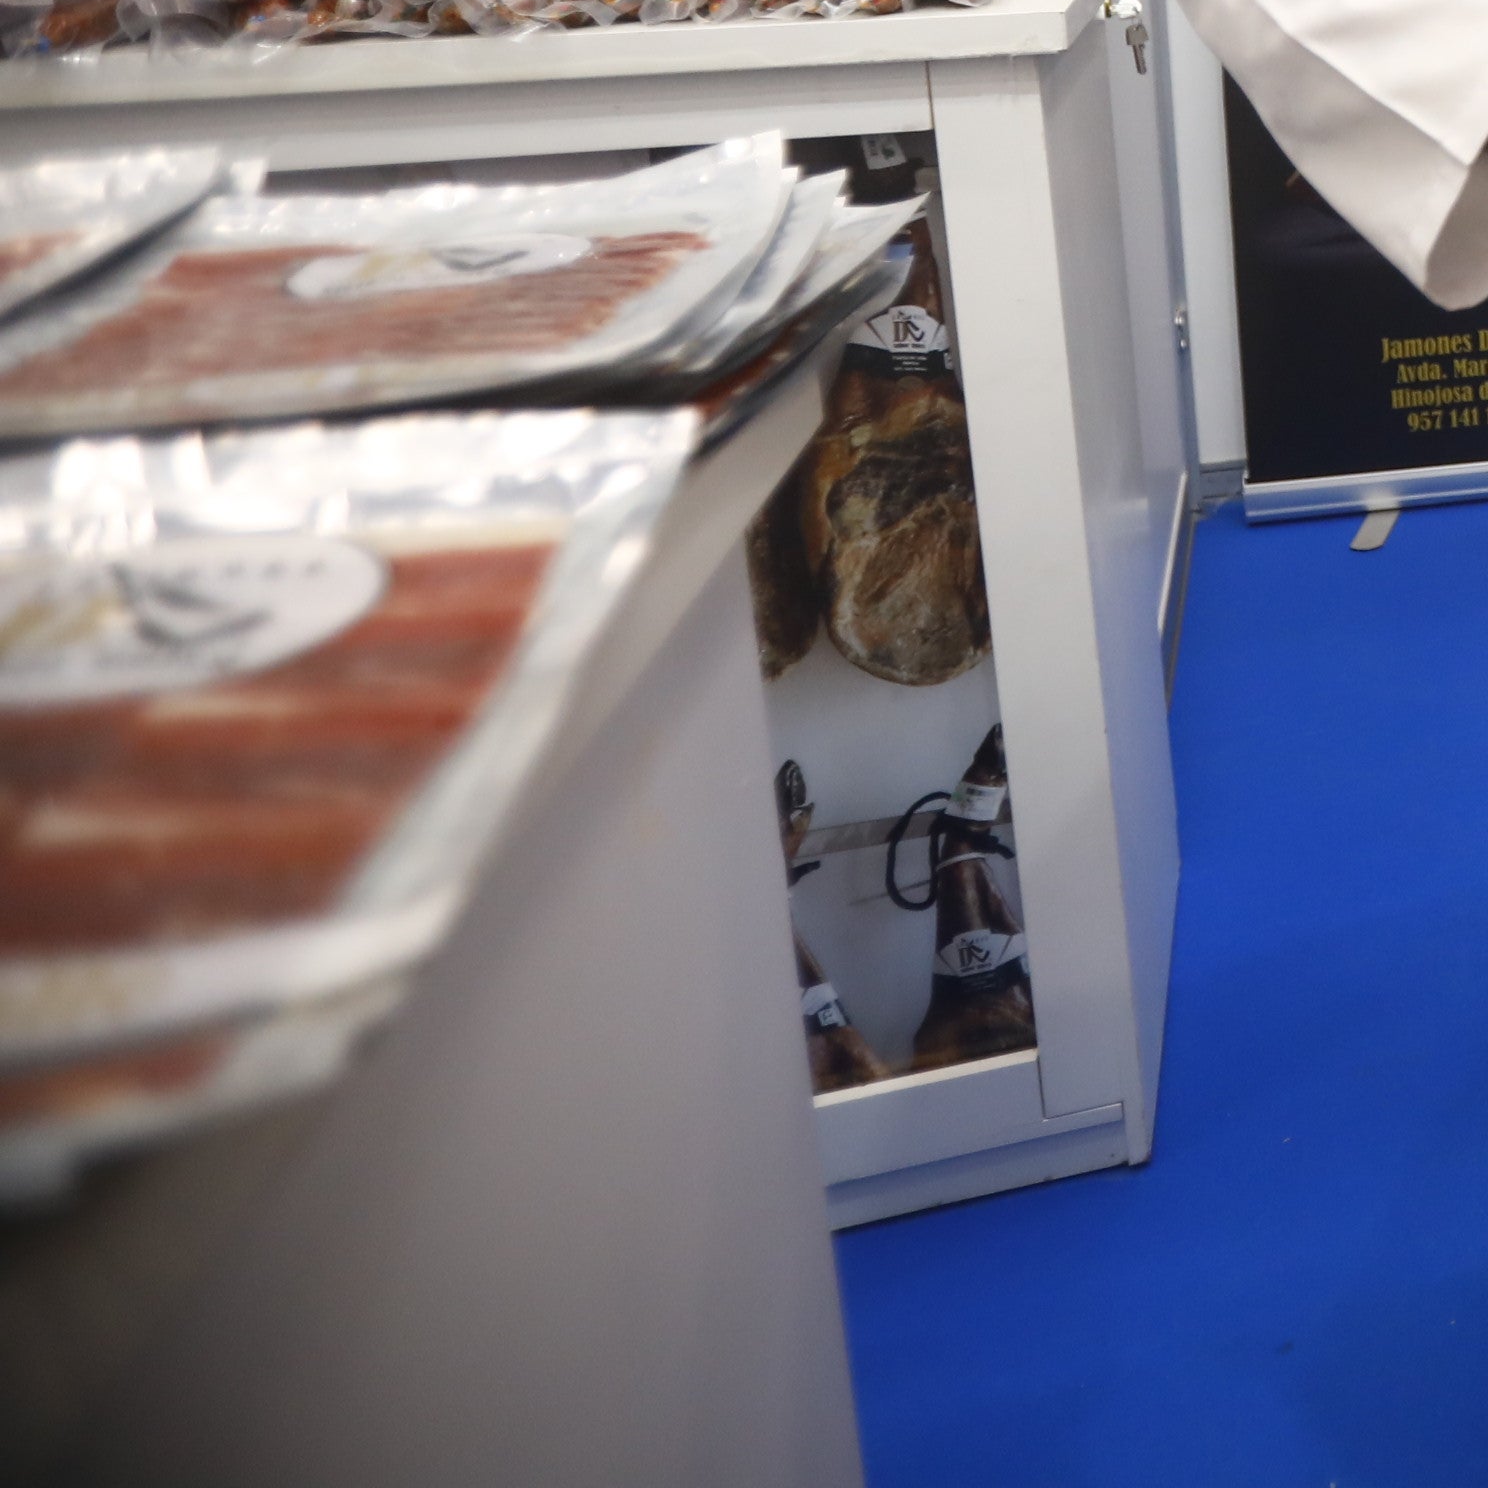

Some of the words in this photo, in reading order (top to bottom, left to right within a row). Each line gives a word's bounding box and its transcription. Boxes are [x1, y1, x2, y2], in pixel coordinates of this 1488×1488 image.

[1382, 333, 1473, 363] Jamones
[1396, 362, 1448, 384] Avda.
[1391, 385, 1473, 409] Hinojosa
[1407, 409, 1443, 432] 957
[1450, 406, 1479, 428] 141
